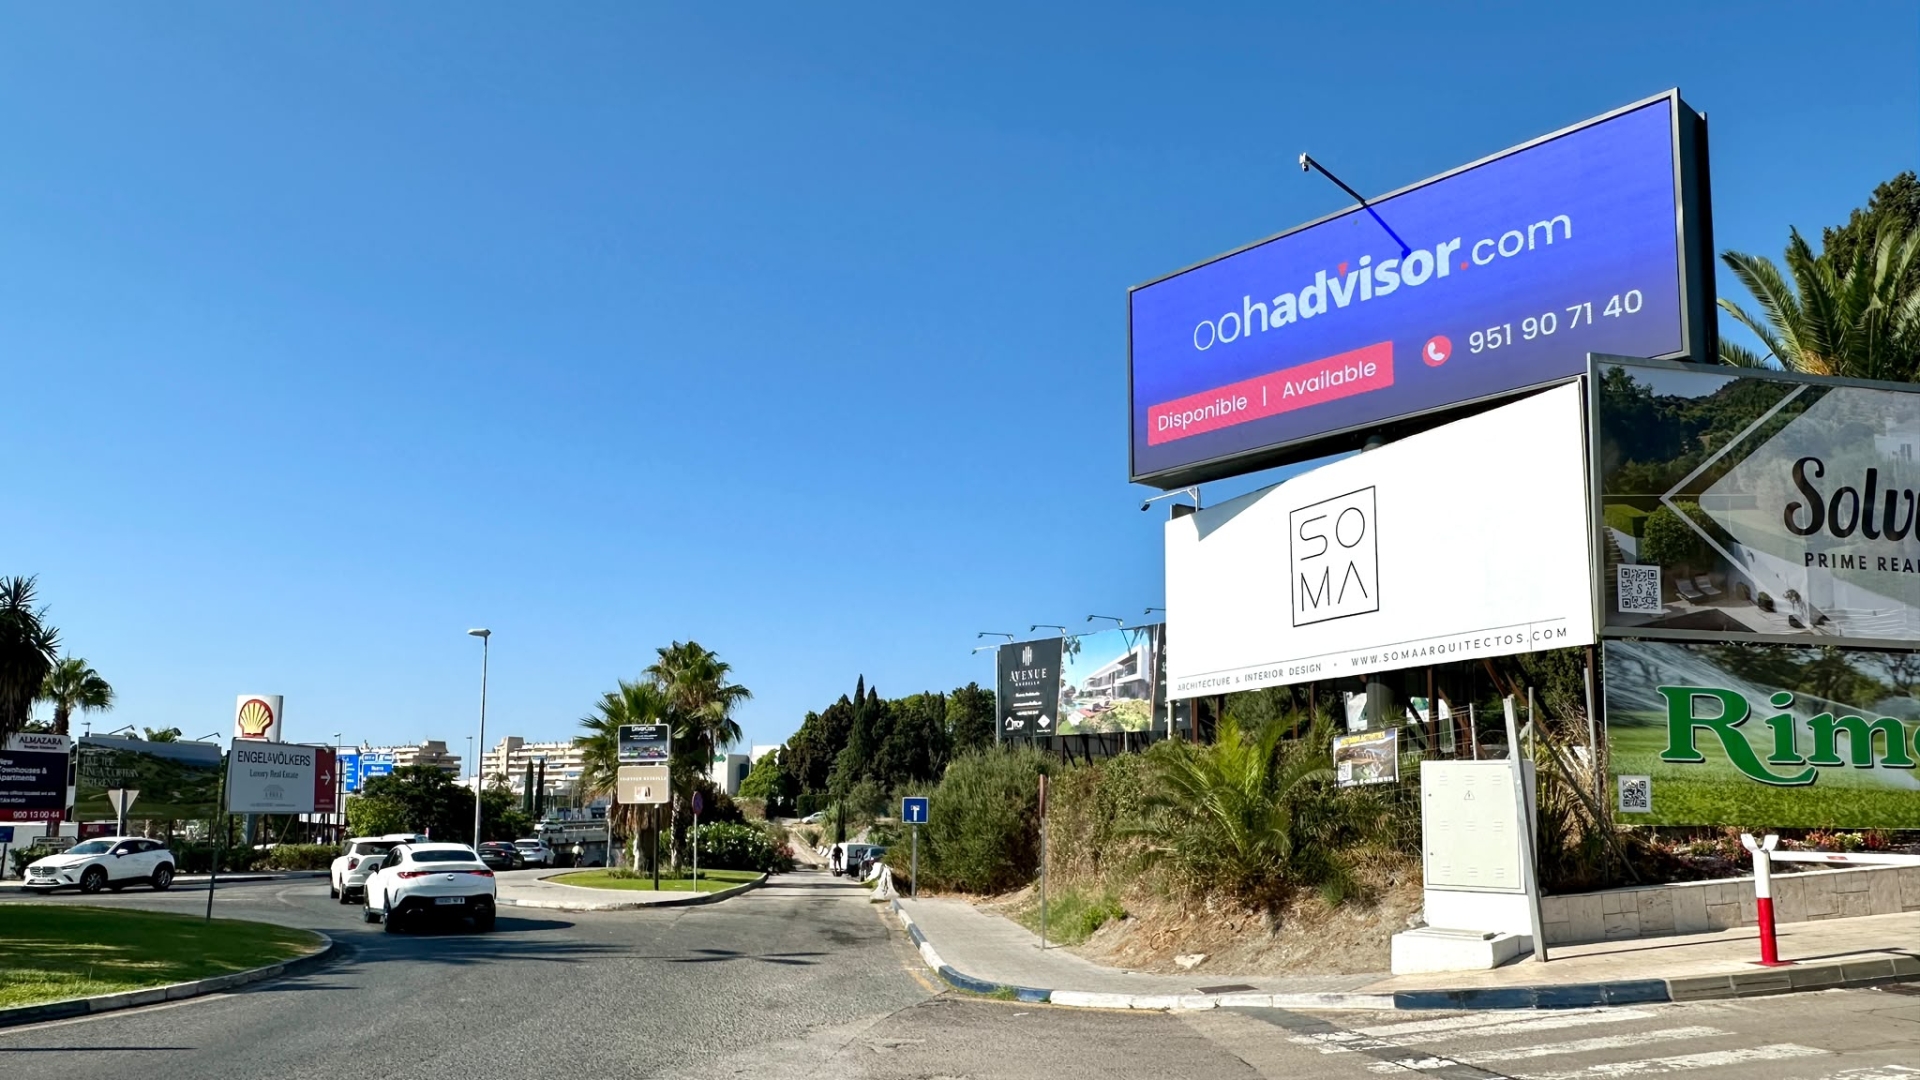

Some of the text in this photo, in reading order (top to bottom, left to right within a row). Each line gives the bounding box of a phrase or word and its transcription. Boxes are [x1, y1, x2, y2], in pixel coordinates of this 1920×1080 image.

[1194, 214, 1571, 351] oohadvisor.com
[1469, 289, 1643, 353] 951 90 71 40
[1158, 395, 1247, 431] Disponible
[1282, 360, 1377, 399] Available
[1784, 457, 1920, 542] Solv
[1804, 552, 1867, 570] PRIME
[1009, 668, 1047, 682] AVENUE
[1177, 676, 1231, 692] ARCHITECTURE
[1244, 669, 1284, 682] INTERIOR
[1289, 663, 1322, 676] DESIGN
[1351, 627, 1567, 667] WWW.SOMAARQUITECTOS.COM
[19, 736, 62, 745] ALMAZARA
[1656, 685, 1920, 785] Rim
[249, 769, 299, 779] Luxury Real Estate
[13, 811, 60, 819] 900 13 00 44
